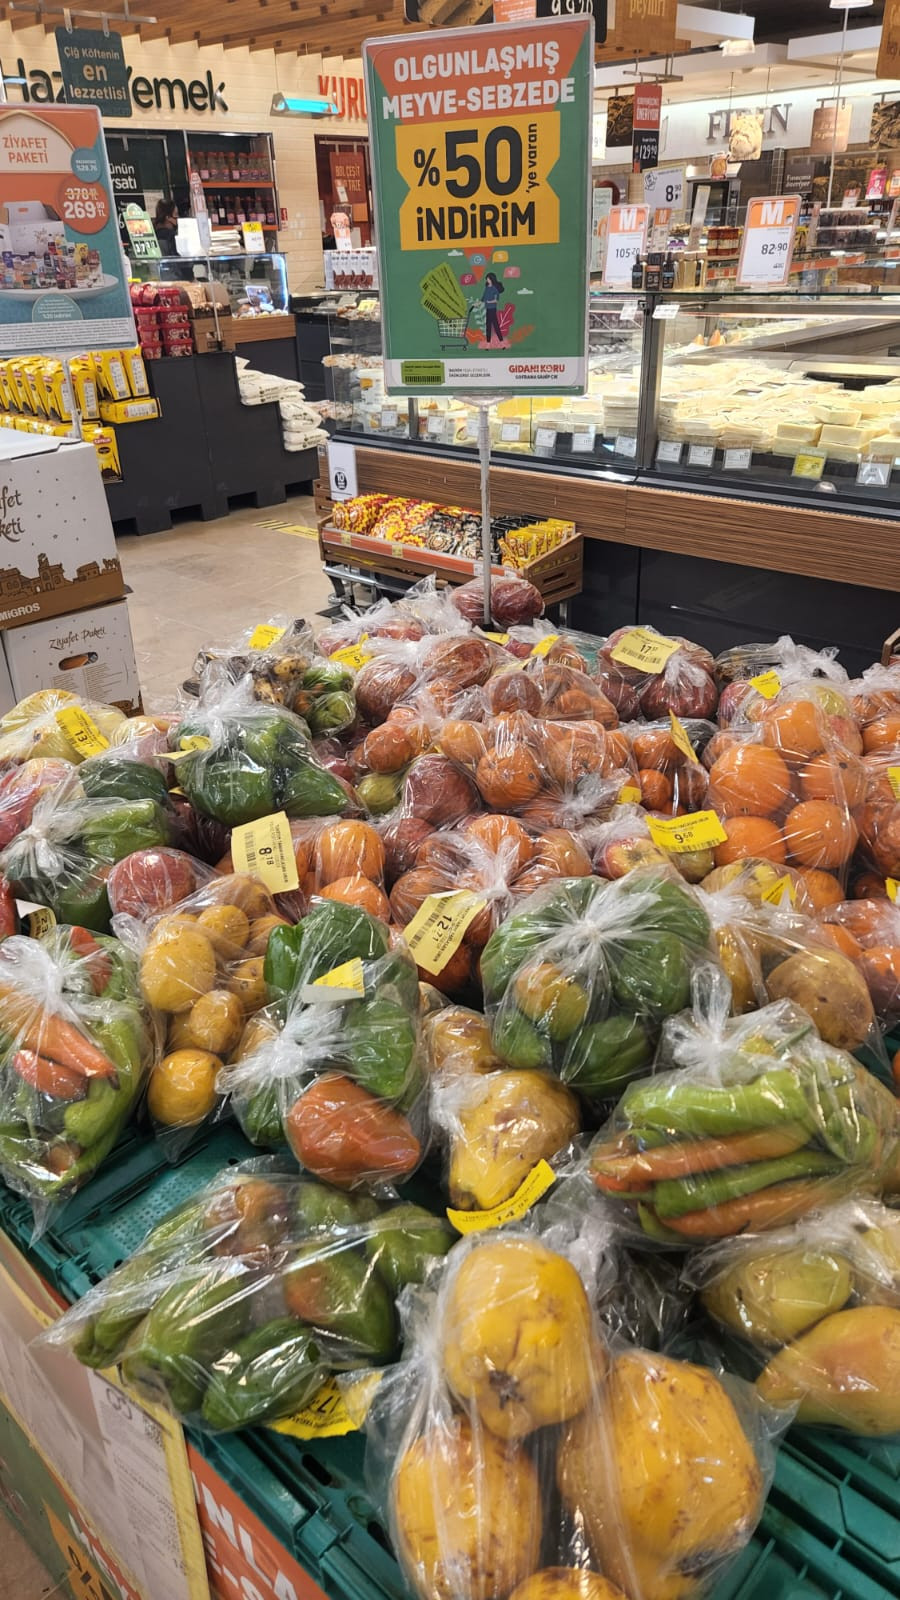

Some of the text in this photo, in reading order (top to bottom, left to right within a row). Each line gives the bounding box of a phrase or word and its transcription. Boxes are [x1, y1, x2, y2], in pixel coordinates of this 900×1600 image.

[64, 46, 120, 60] Çiğ Köftenin
[393, 40, 560, 83] OLGUNLAŞMIŞ
[83, 64, 108, 81] en
[69, 84, 127, 100] lezzetlisi
[382, 77, 576, 121] MEYVE-SEBZEDE
[706, 102, 793, 140] FIN
[2, 134, 48, 149] ZİYAFET
[527, 122, 538, 167] varan
[8, 150, 48, 164] PAKETİ
[413, 125, 523, 199] %50
[63, 201, 96, 219] 269
[760, 200, 784, 225] M
[48, 626, 107, 651] Ziyafet Paketi
